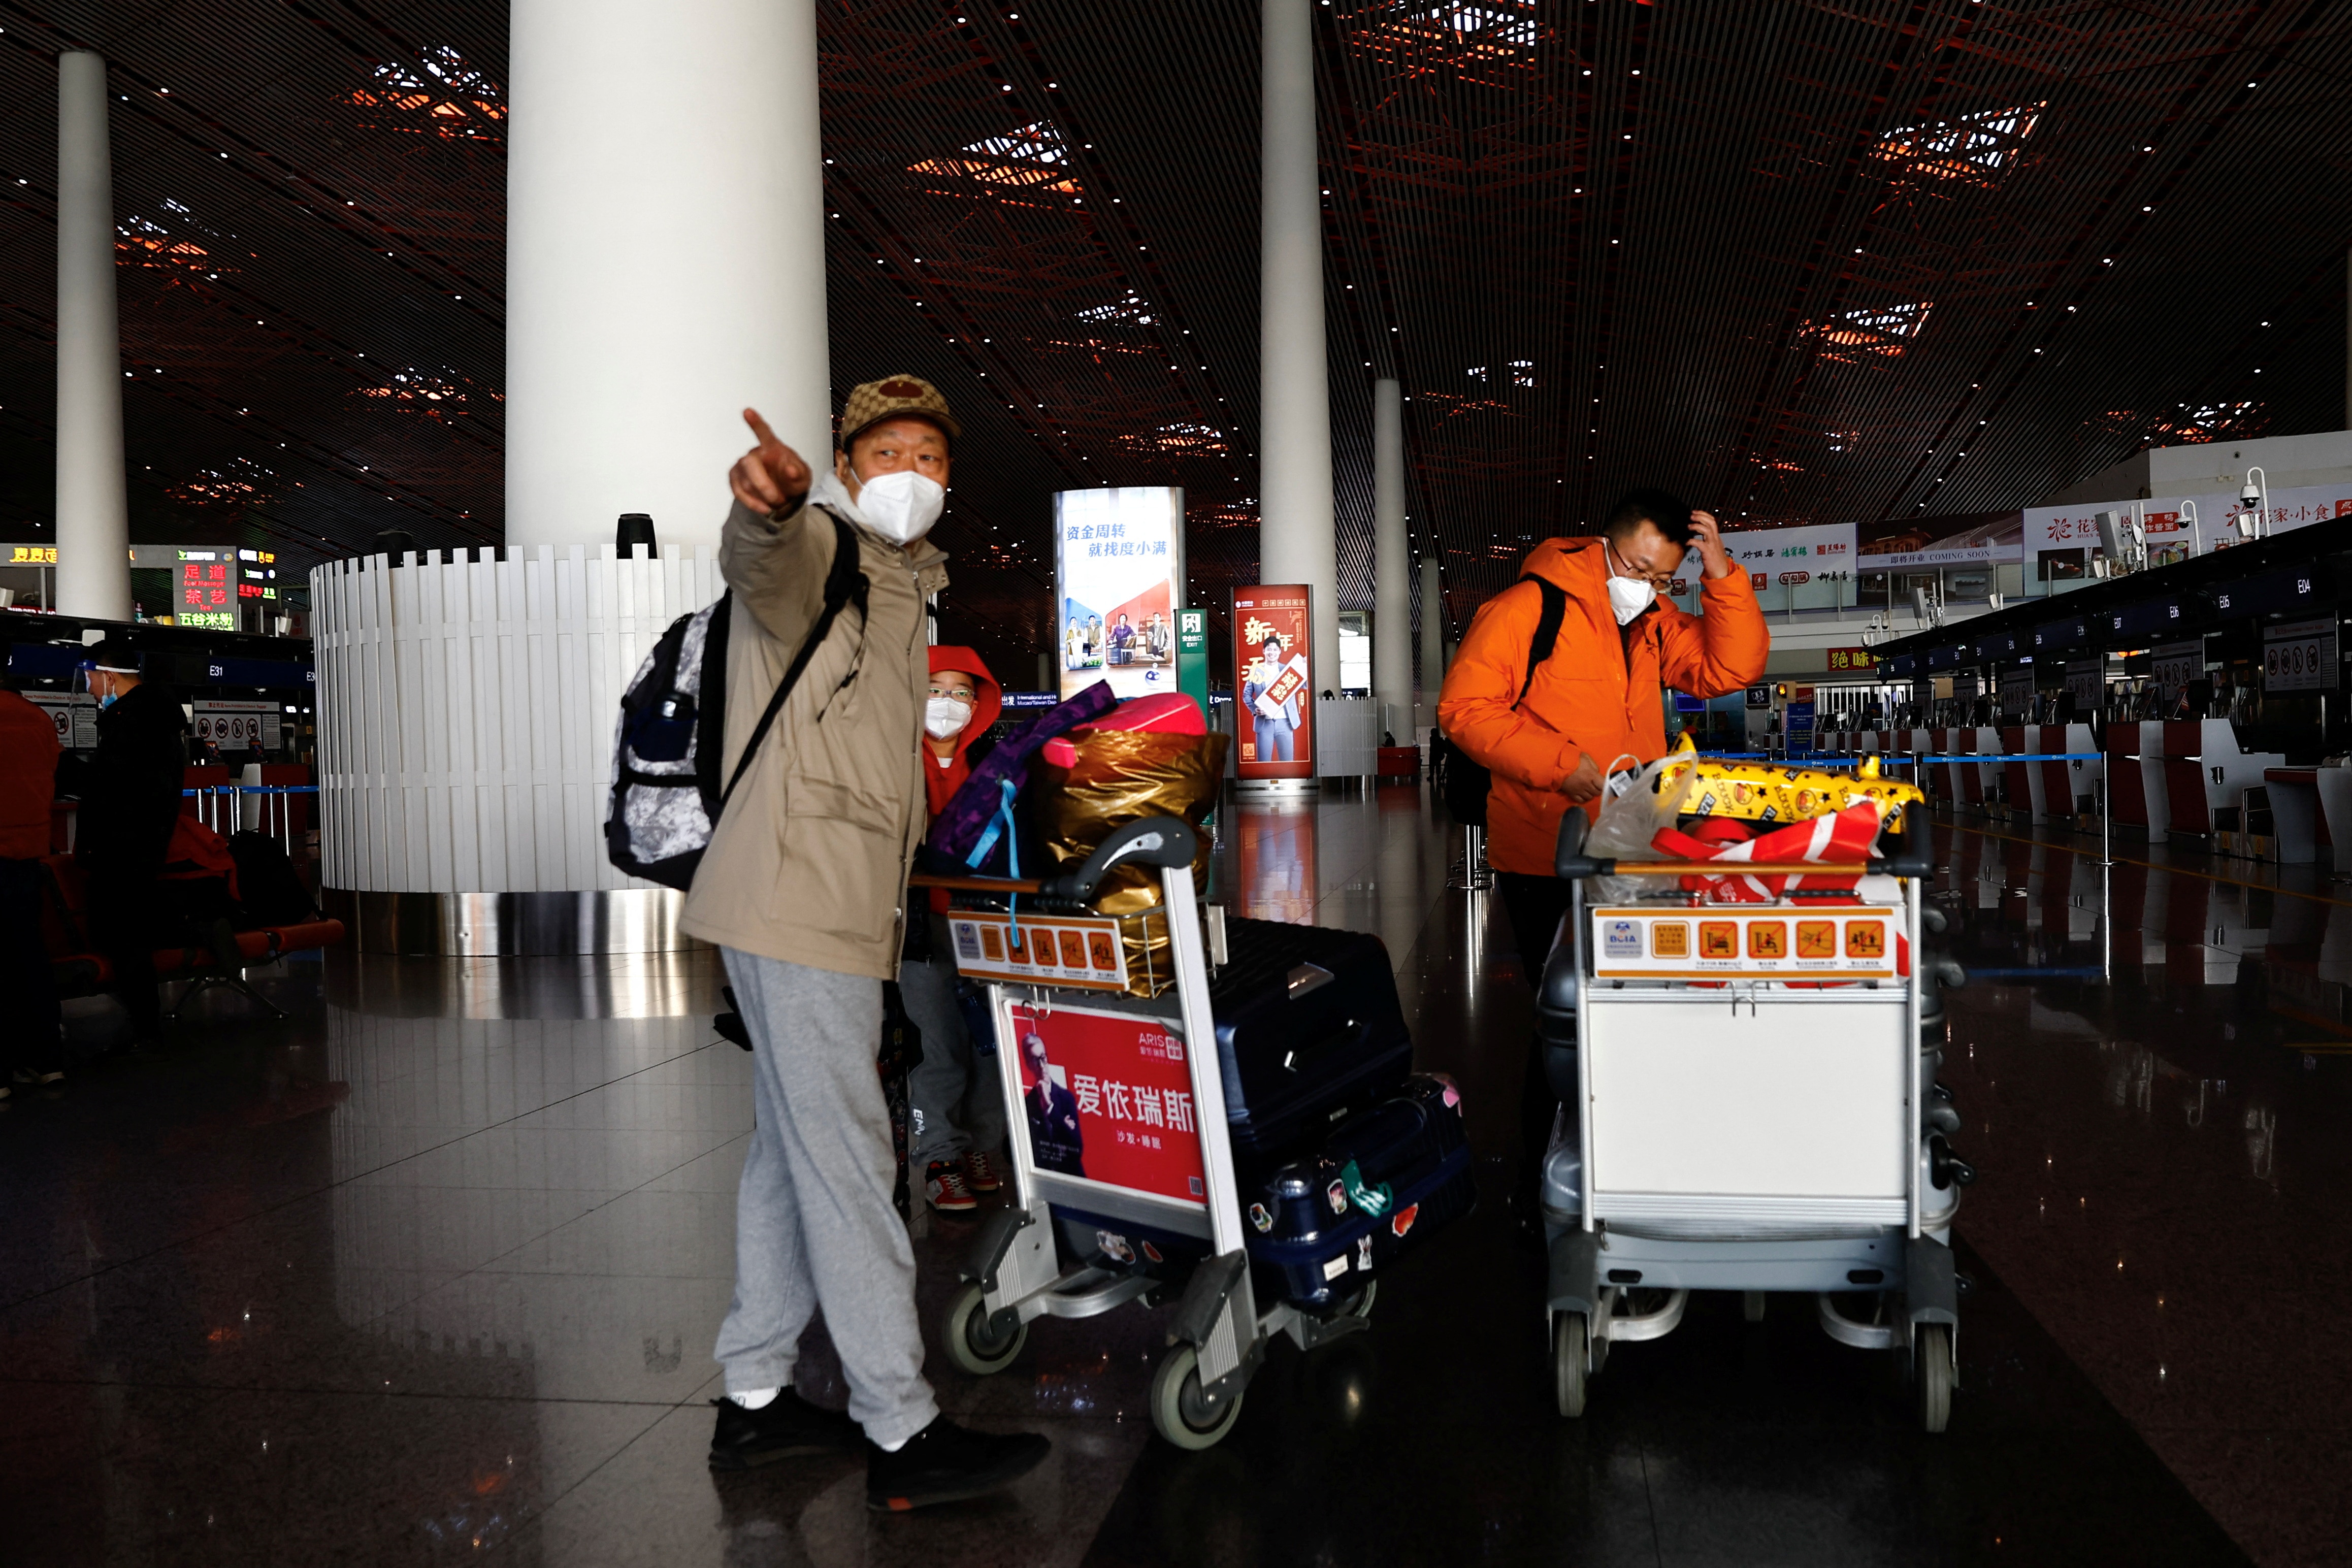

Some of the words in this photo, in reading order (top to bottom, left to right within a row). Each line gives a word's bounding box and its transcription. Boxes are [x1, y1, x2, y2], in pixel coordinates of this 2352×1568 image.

[1066, 524, 1126, 541] 资金周转
[1089, 541, 1167, 558] 就找度小满
[1930, 552, 1963, 561] COMING
[1967, 550, 1990, 558] SOON
[1891, 554, 1925, 564] 即将开业
[184, 564, 226, 579] 足道
[2298, 579, 2311, 594] E04
[185, 589, 227, 604] 茶艺
[2219, 595, 2230, 608] E05
[178, 612, 234, 626] 五谷米粉
[2170, 606, 2179, 618] E06
[210, 666, 222, 676] E31
[1609, 935, 1636, 943] BCIA
[1139, 1032, 1165, 1048] ARIS
[1074, 1073, 1194, 1133] 爱依瑞斯
